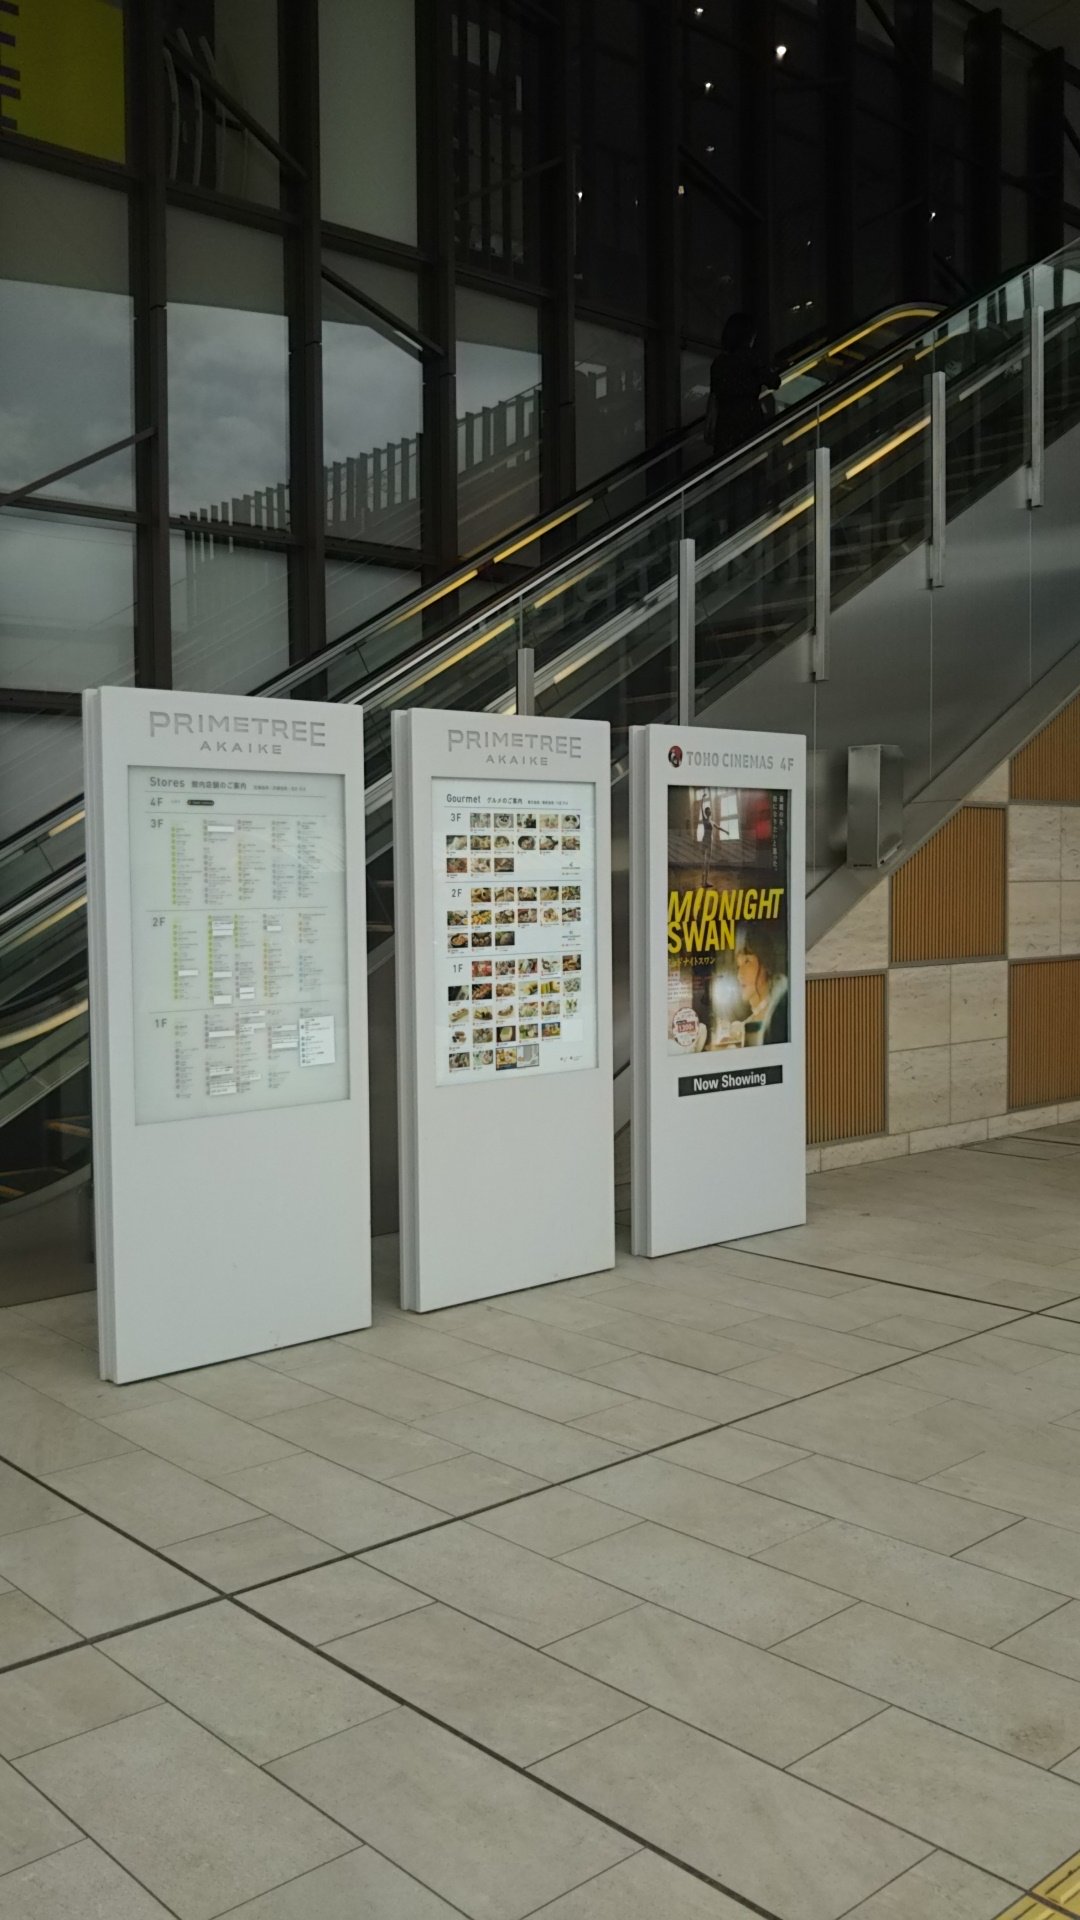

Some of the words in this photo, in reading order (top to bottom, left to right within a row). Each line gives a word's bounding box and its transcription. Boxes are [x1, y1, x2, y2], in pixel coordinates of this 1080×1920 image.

[149, 711, 326, 753] PRIMETREE
[199, 740, 282, 755] AKAIKE
[448, 729, 581, 759] PRIMETREE
[486, 754, 549, 766] AKAIKE
[686, 750, 719, 767] TOHO
[724, 753, 774, 771] CINEMAS
[780, 757, 795, 772] 4F
[149, 776, 186, 788] Stores
[149, 797, 164, 807] 4F
[446, 793, 481, 804] Gourmet
[150, 818, 164, 829] 3F
[450, 812, 462, 823] 3F
[451, 888, 463, 898] 2F
[668, 887, 784, 923] MIDNIGHT
[152, 916, 166, 928] 2F
[668, 920, 736, 954] SWAN
[452, 963, 464, 973] 1F
[154, 1017, 168, 1029] 1F
[693, 1077, 718, 1092] Now
[721, 1071, 767, 1088] Showing
